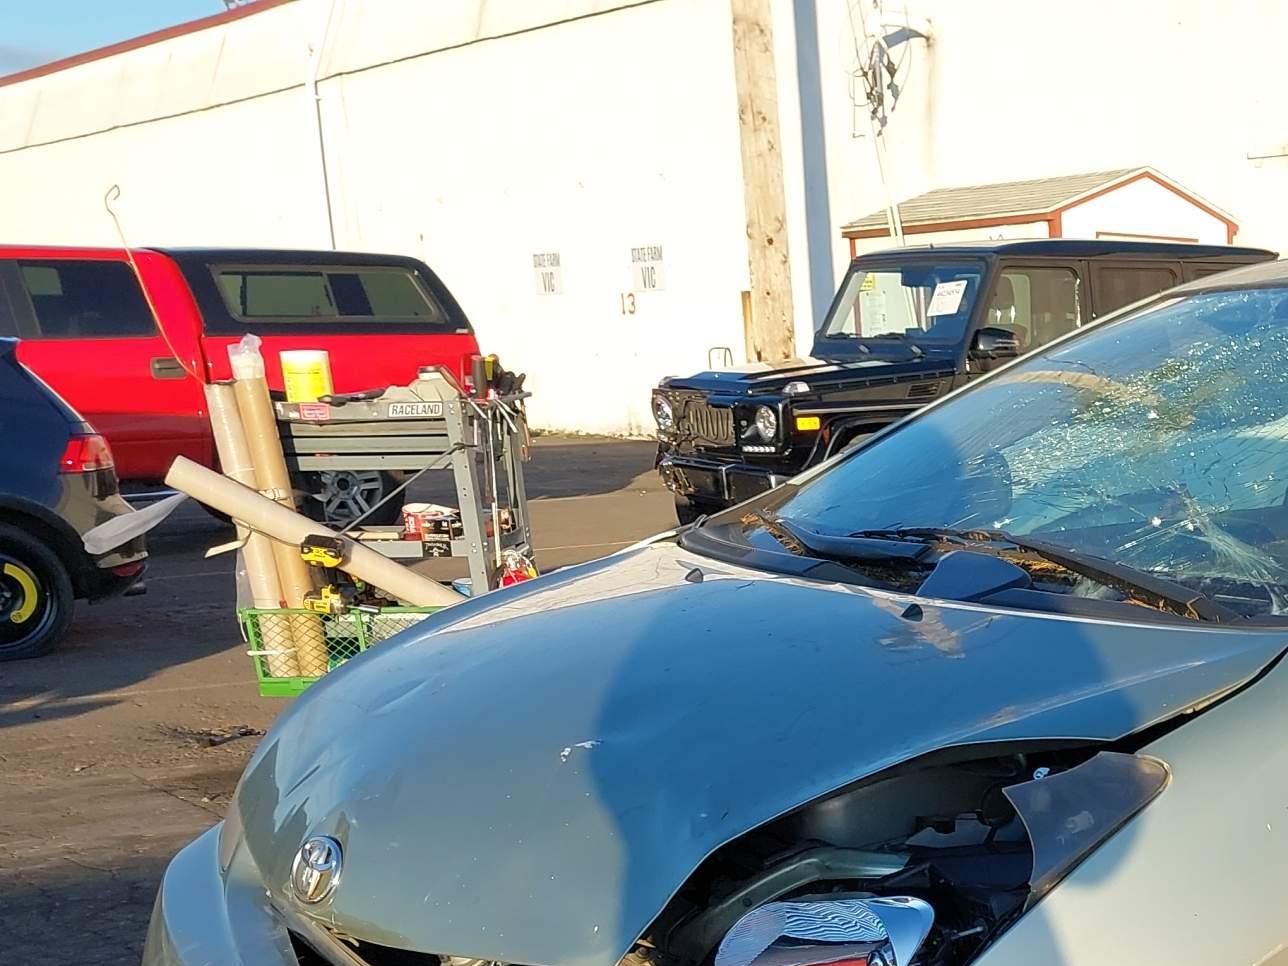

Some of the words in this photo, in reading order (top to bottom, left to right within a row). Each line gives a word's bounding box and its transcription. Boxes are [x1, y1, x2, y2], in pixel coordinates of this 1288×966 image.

[631, 247, 647, 263] STATE
[647, 245, 663, 261] FARM
[541, 271, 555, 293] VIC
[641, 266, 657, 289] VIC
[620, 292, 637, 316] 13
[391, 404, 440, 415] RACELAND
